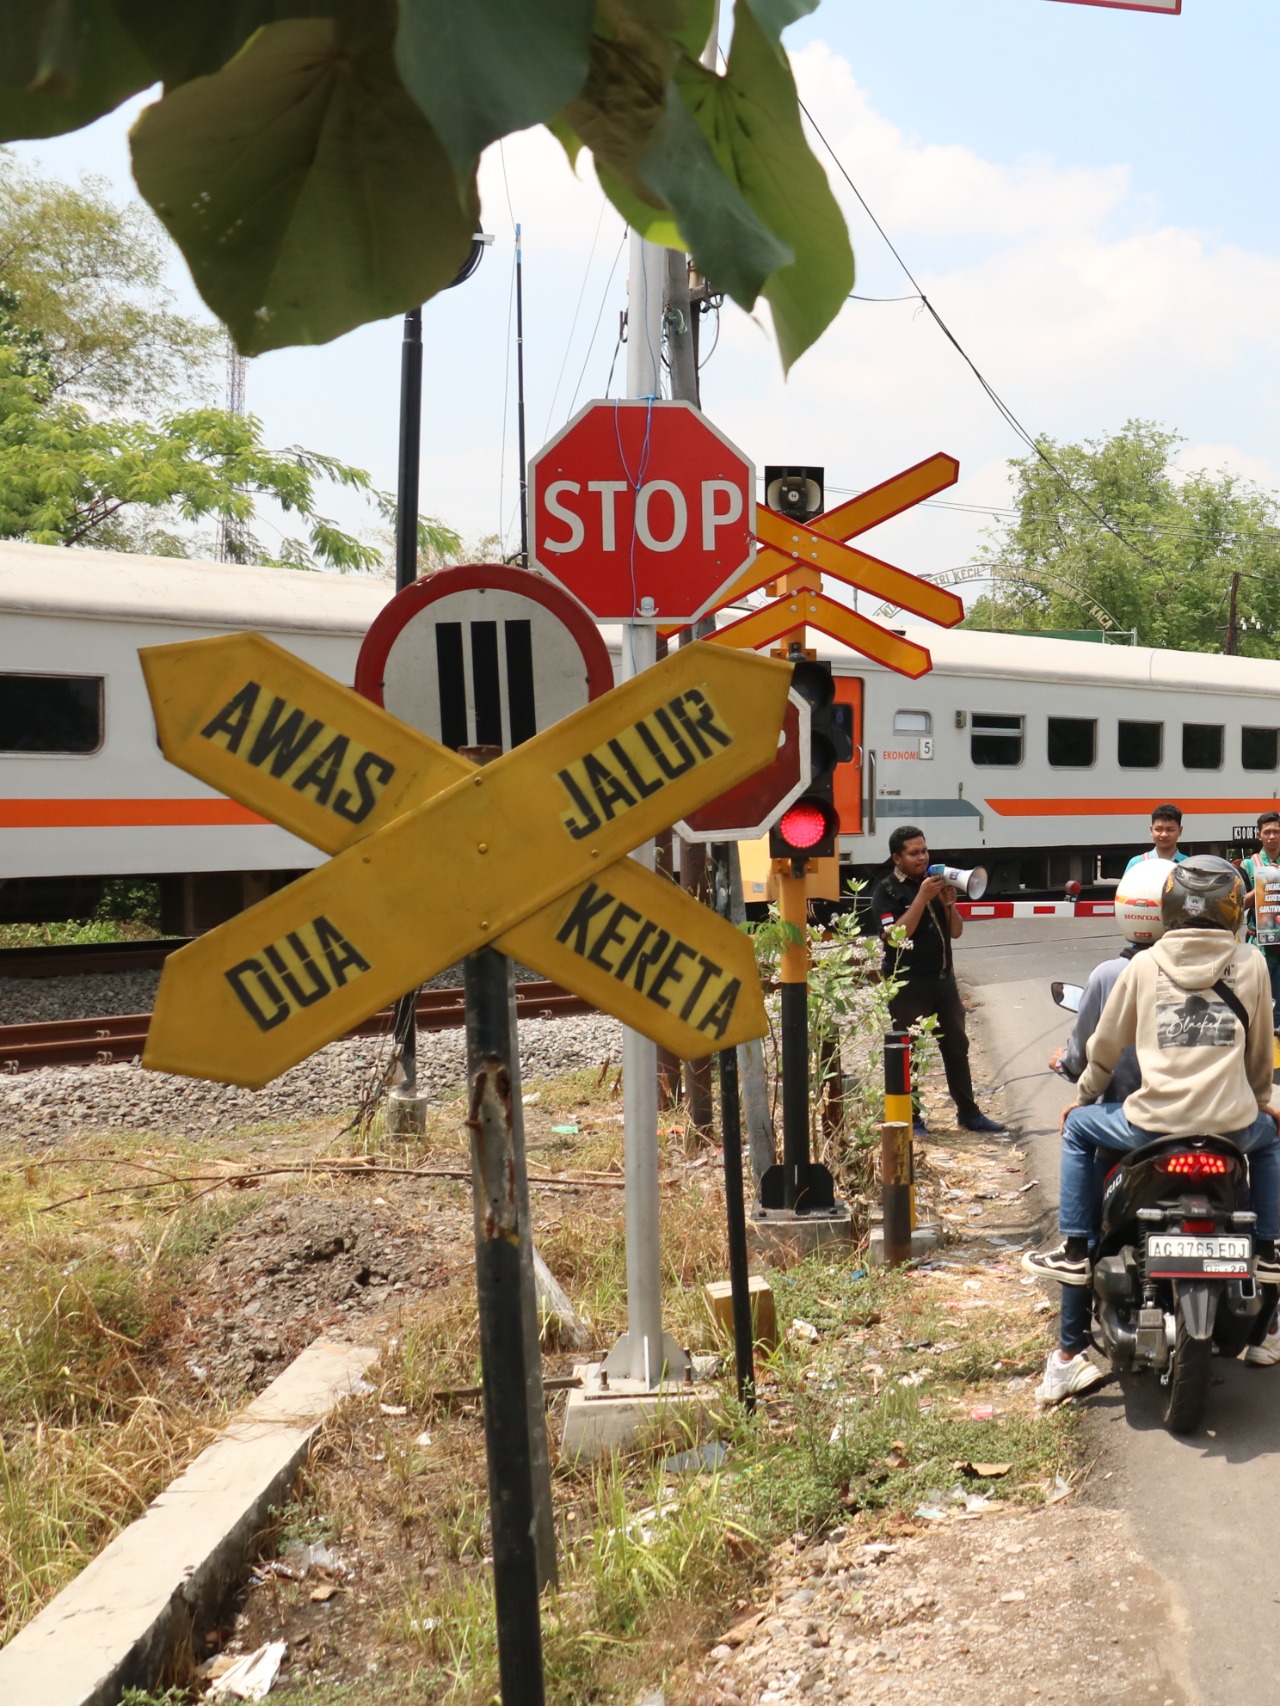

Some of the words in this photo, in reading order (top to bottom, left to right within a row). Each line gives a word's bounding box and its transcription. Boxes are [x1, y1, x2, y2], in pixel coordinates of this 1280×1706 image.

[543, 479, 744, 555] STOP
[952, 567, 984, 582] KECIL
[1088, 604, 1114, 630] KACA
[200, 680, 396, 825] AWAS
[555, 687, 734, 841] JALUR
[883, 751, 919, 760] EKONOMI
[923, 742, 931, 754] 5
[223, 915, 373, 1033] DUA
[555, 881, 743, 1041] KERETA
[1177, 1242, 1214, 1257] 3765
[1218, 1243, 1247, 1259] EDJ
